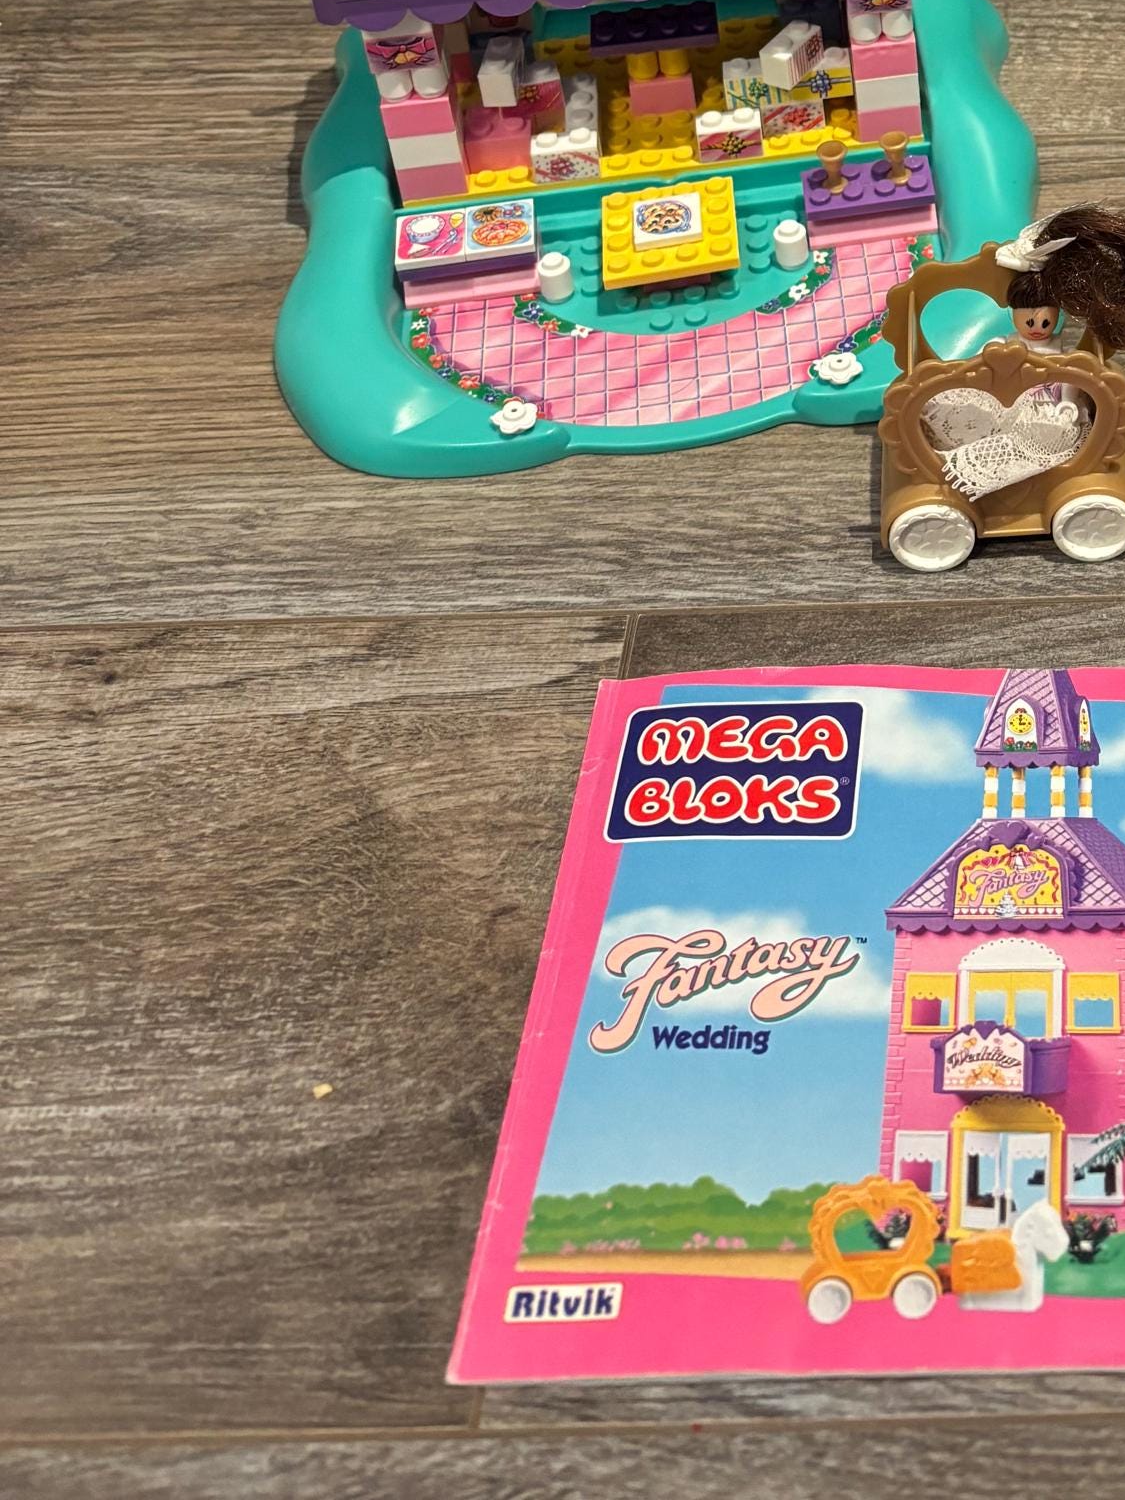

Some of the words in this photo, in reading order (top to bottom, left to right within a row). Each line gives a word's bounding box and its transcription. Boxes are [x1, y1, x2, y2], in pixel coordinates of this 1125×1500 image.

[637, 714, 849, 765] MEGA
[624, 775, 841, 826] BLOKS
[968, 868, 1049, 907] Fantasy
[589, 929, 860, 1054] Fantasy
[652, 1025, 771, 1053] Wedding
[511, 1288, 614, 1317] Ritvik
